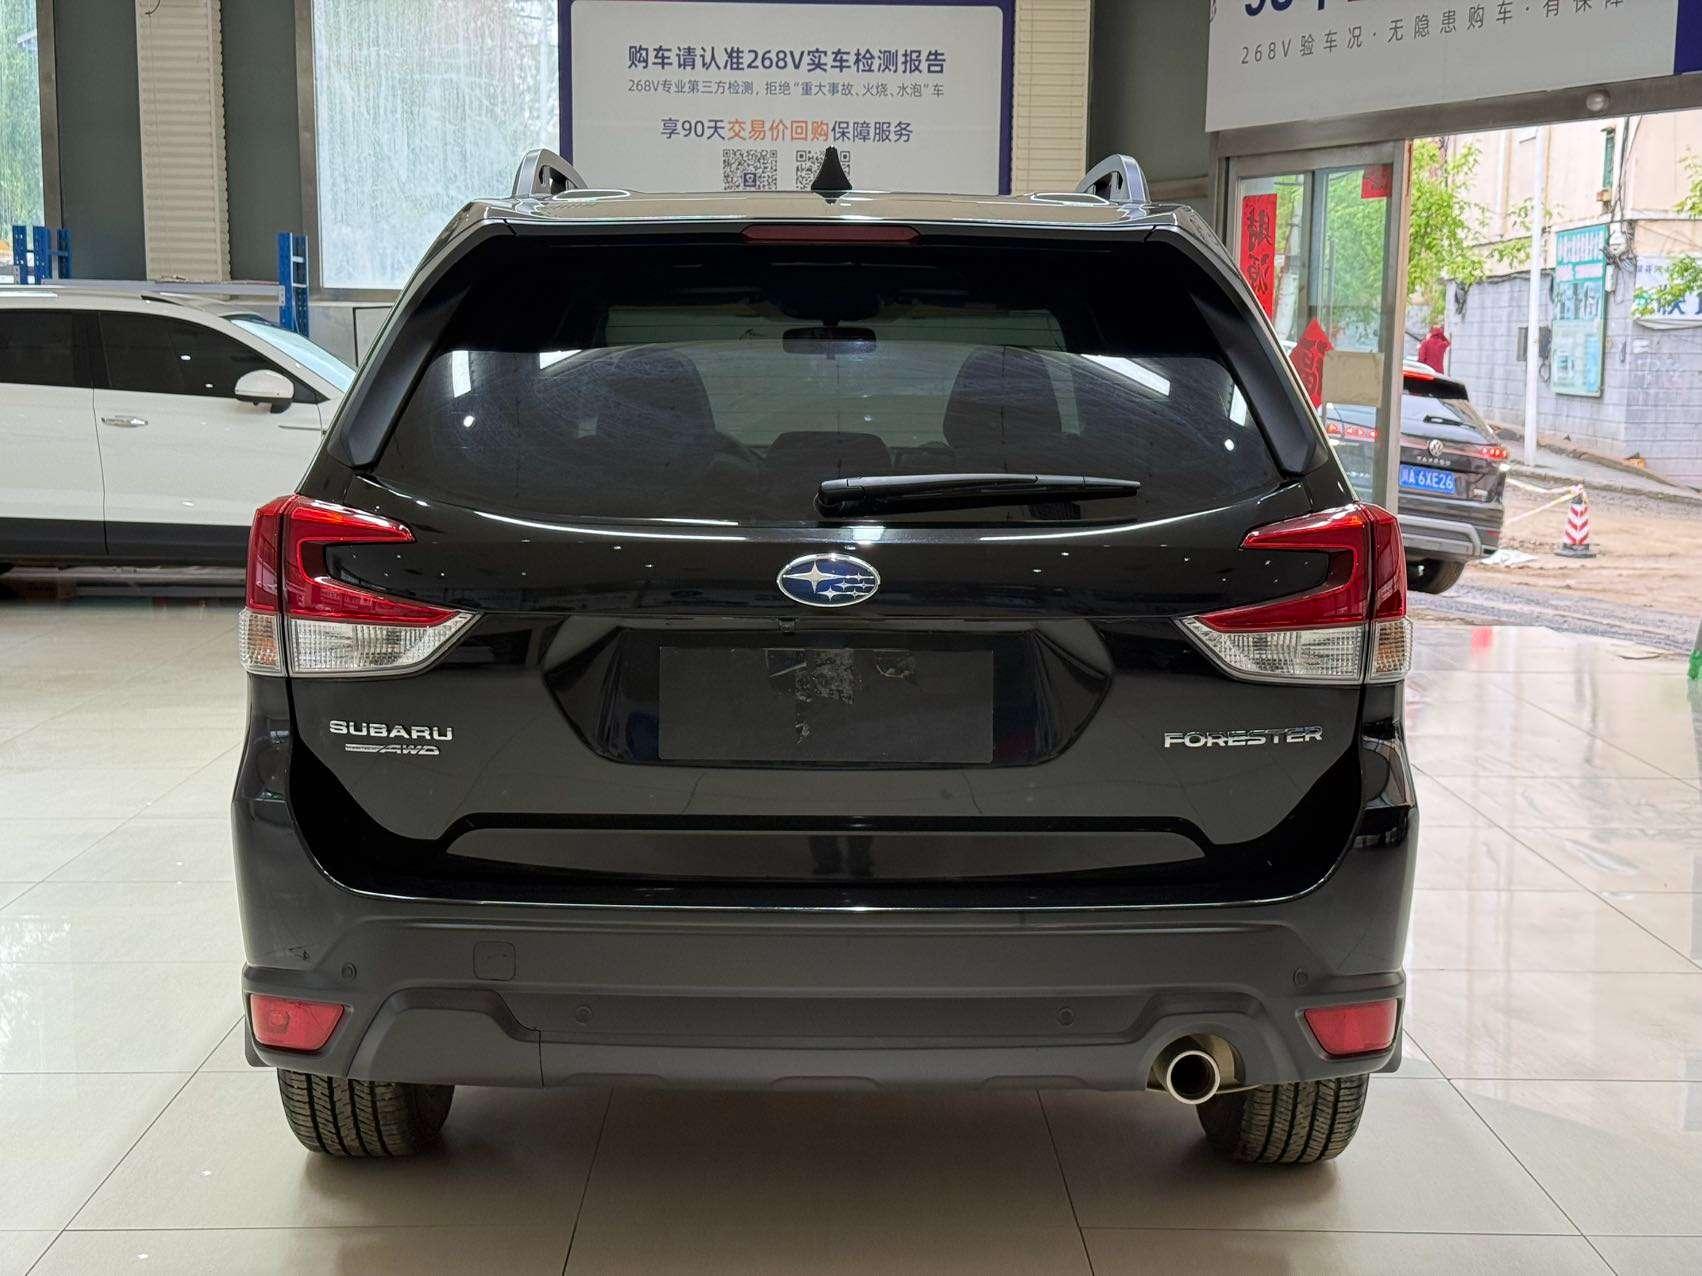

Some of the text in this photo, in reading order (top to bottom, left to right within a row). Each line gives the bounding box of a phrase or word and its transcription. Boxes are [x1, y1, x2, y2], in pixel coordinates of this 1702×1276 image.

[627, 45, 947, 75] 购车请认准268V实车检测报告
[660, 118, 914, 144] 享90天交易价回购保障服务
[329, 720, 453, 741] SUBARU
[1163, 725, 1323, 749] FORESTER
[379, 744, 440, 755] AWD
